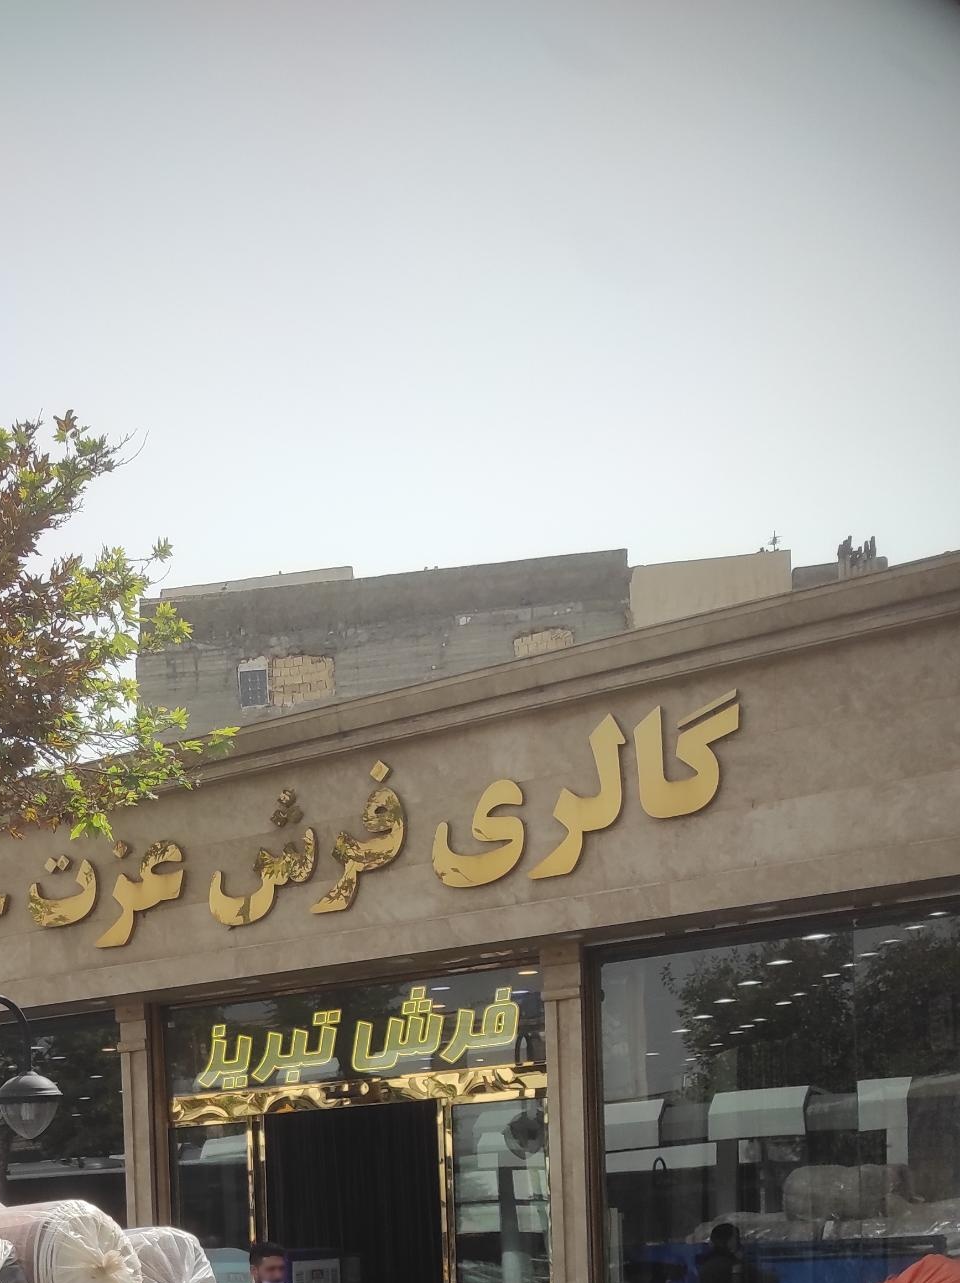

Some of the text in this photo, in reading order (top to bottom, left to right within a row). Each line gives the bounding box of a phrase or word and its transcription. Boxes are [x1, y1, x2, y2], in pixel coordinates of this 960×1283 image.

[209, 759, 407, 929] فرش
[432, 688, 740, 888] گالری
[27, 839, 186, 949] عزت
[198, 985, 519, 1090] فرش تبریز
